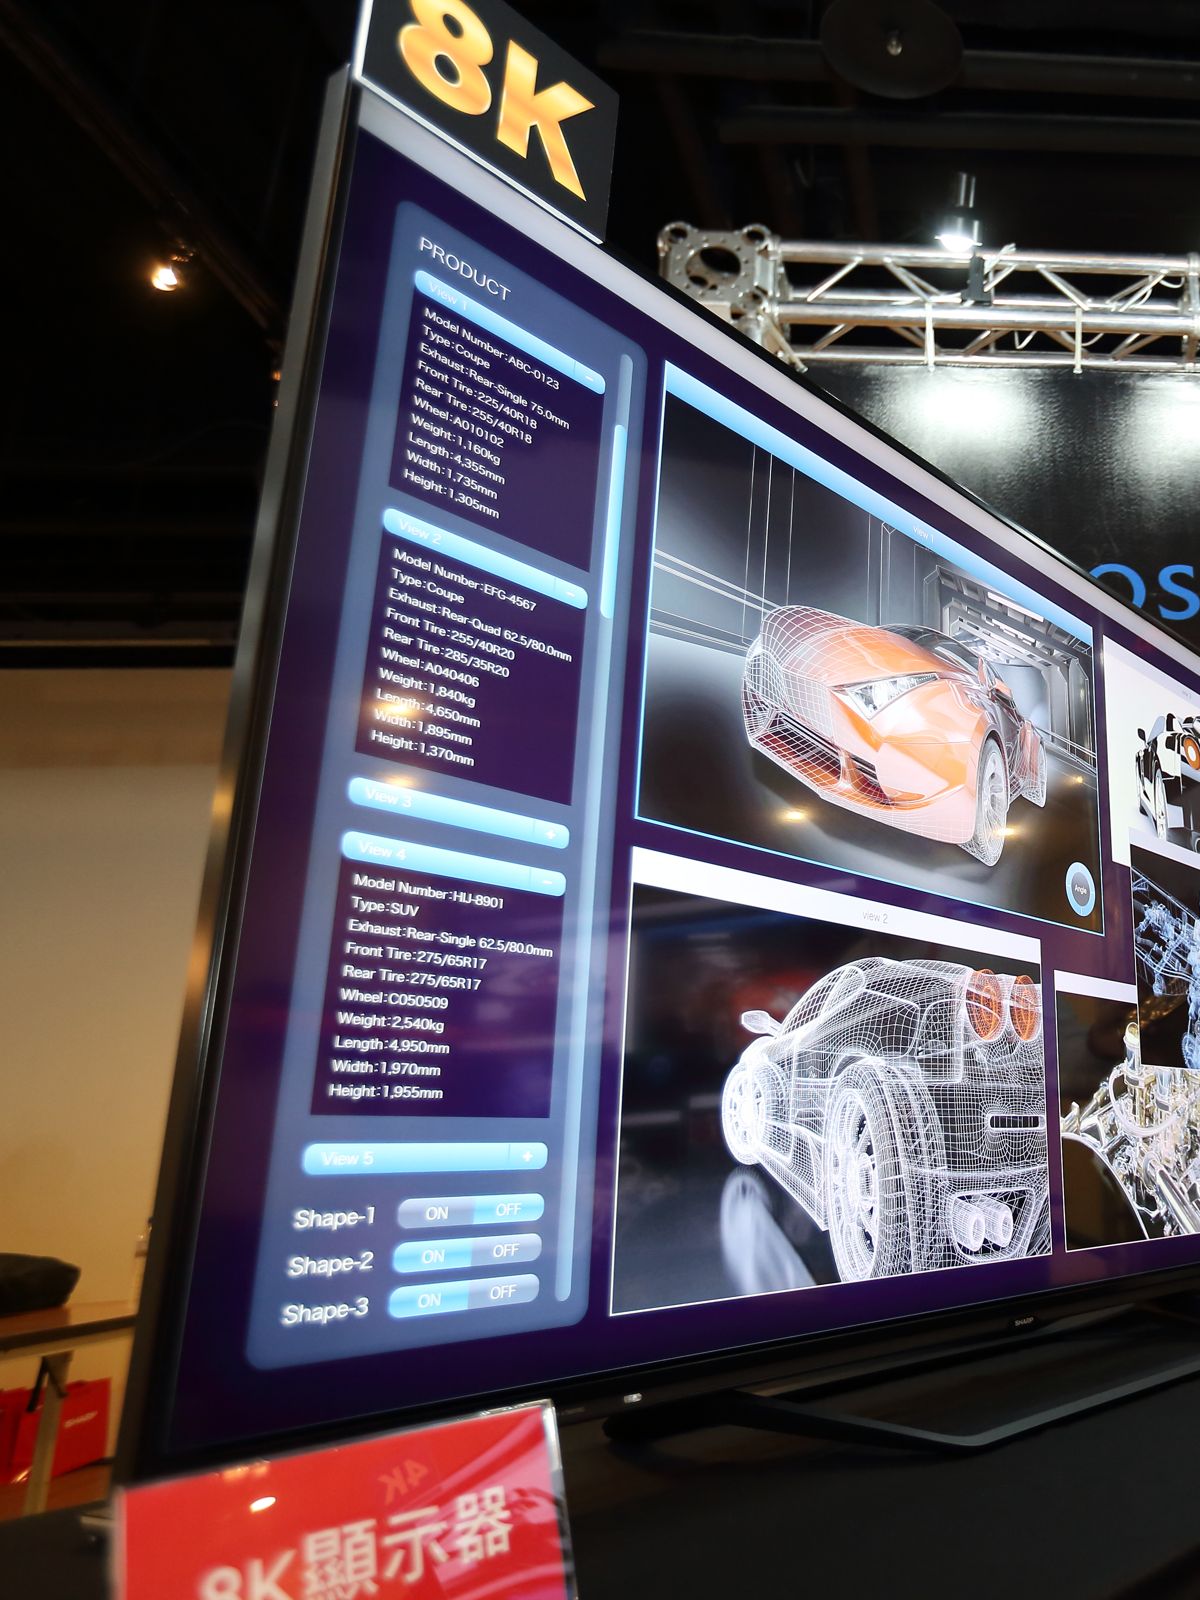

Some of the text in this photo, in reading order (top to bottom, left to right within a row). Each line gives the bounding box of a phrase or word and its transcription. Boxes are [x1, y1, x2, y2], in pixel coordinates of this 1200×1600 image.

[397, 0, 596, 201] 8K
[420, 236, 512, 301] PRODUCT
[424, 307, 459, 335] Model
[418, 360, 450, 384] Front
[415, 377, 443, 398] Rear
[530, 402, 570, 430] 75.0mm
[393, 548, 431, 572] Model
[386, 607, 420, 630] Front
[384, 626, 413, 646] Rear
[353, 873, 395, 892] Model
[346, 942, 383, 958] Front
[343, 965, 376, 979] Rear
[320, 1151, 359, 1166] View
[293, 1203, 522, 1231] Shape-1 ON OFF
[287, 1243, 520, 1277] Shape-2 ON OFF
[281, 1284, 517, 1326] Shape-3 ON OFF
